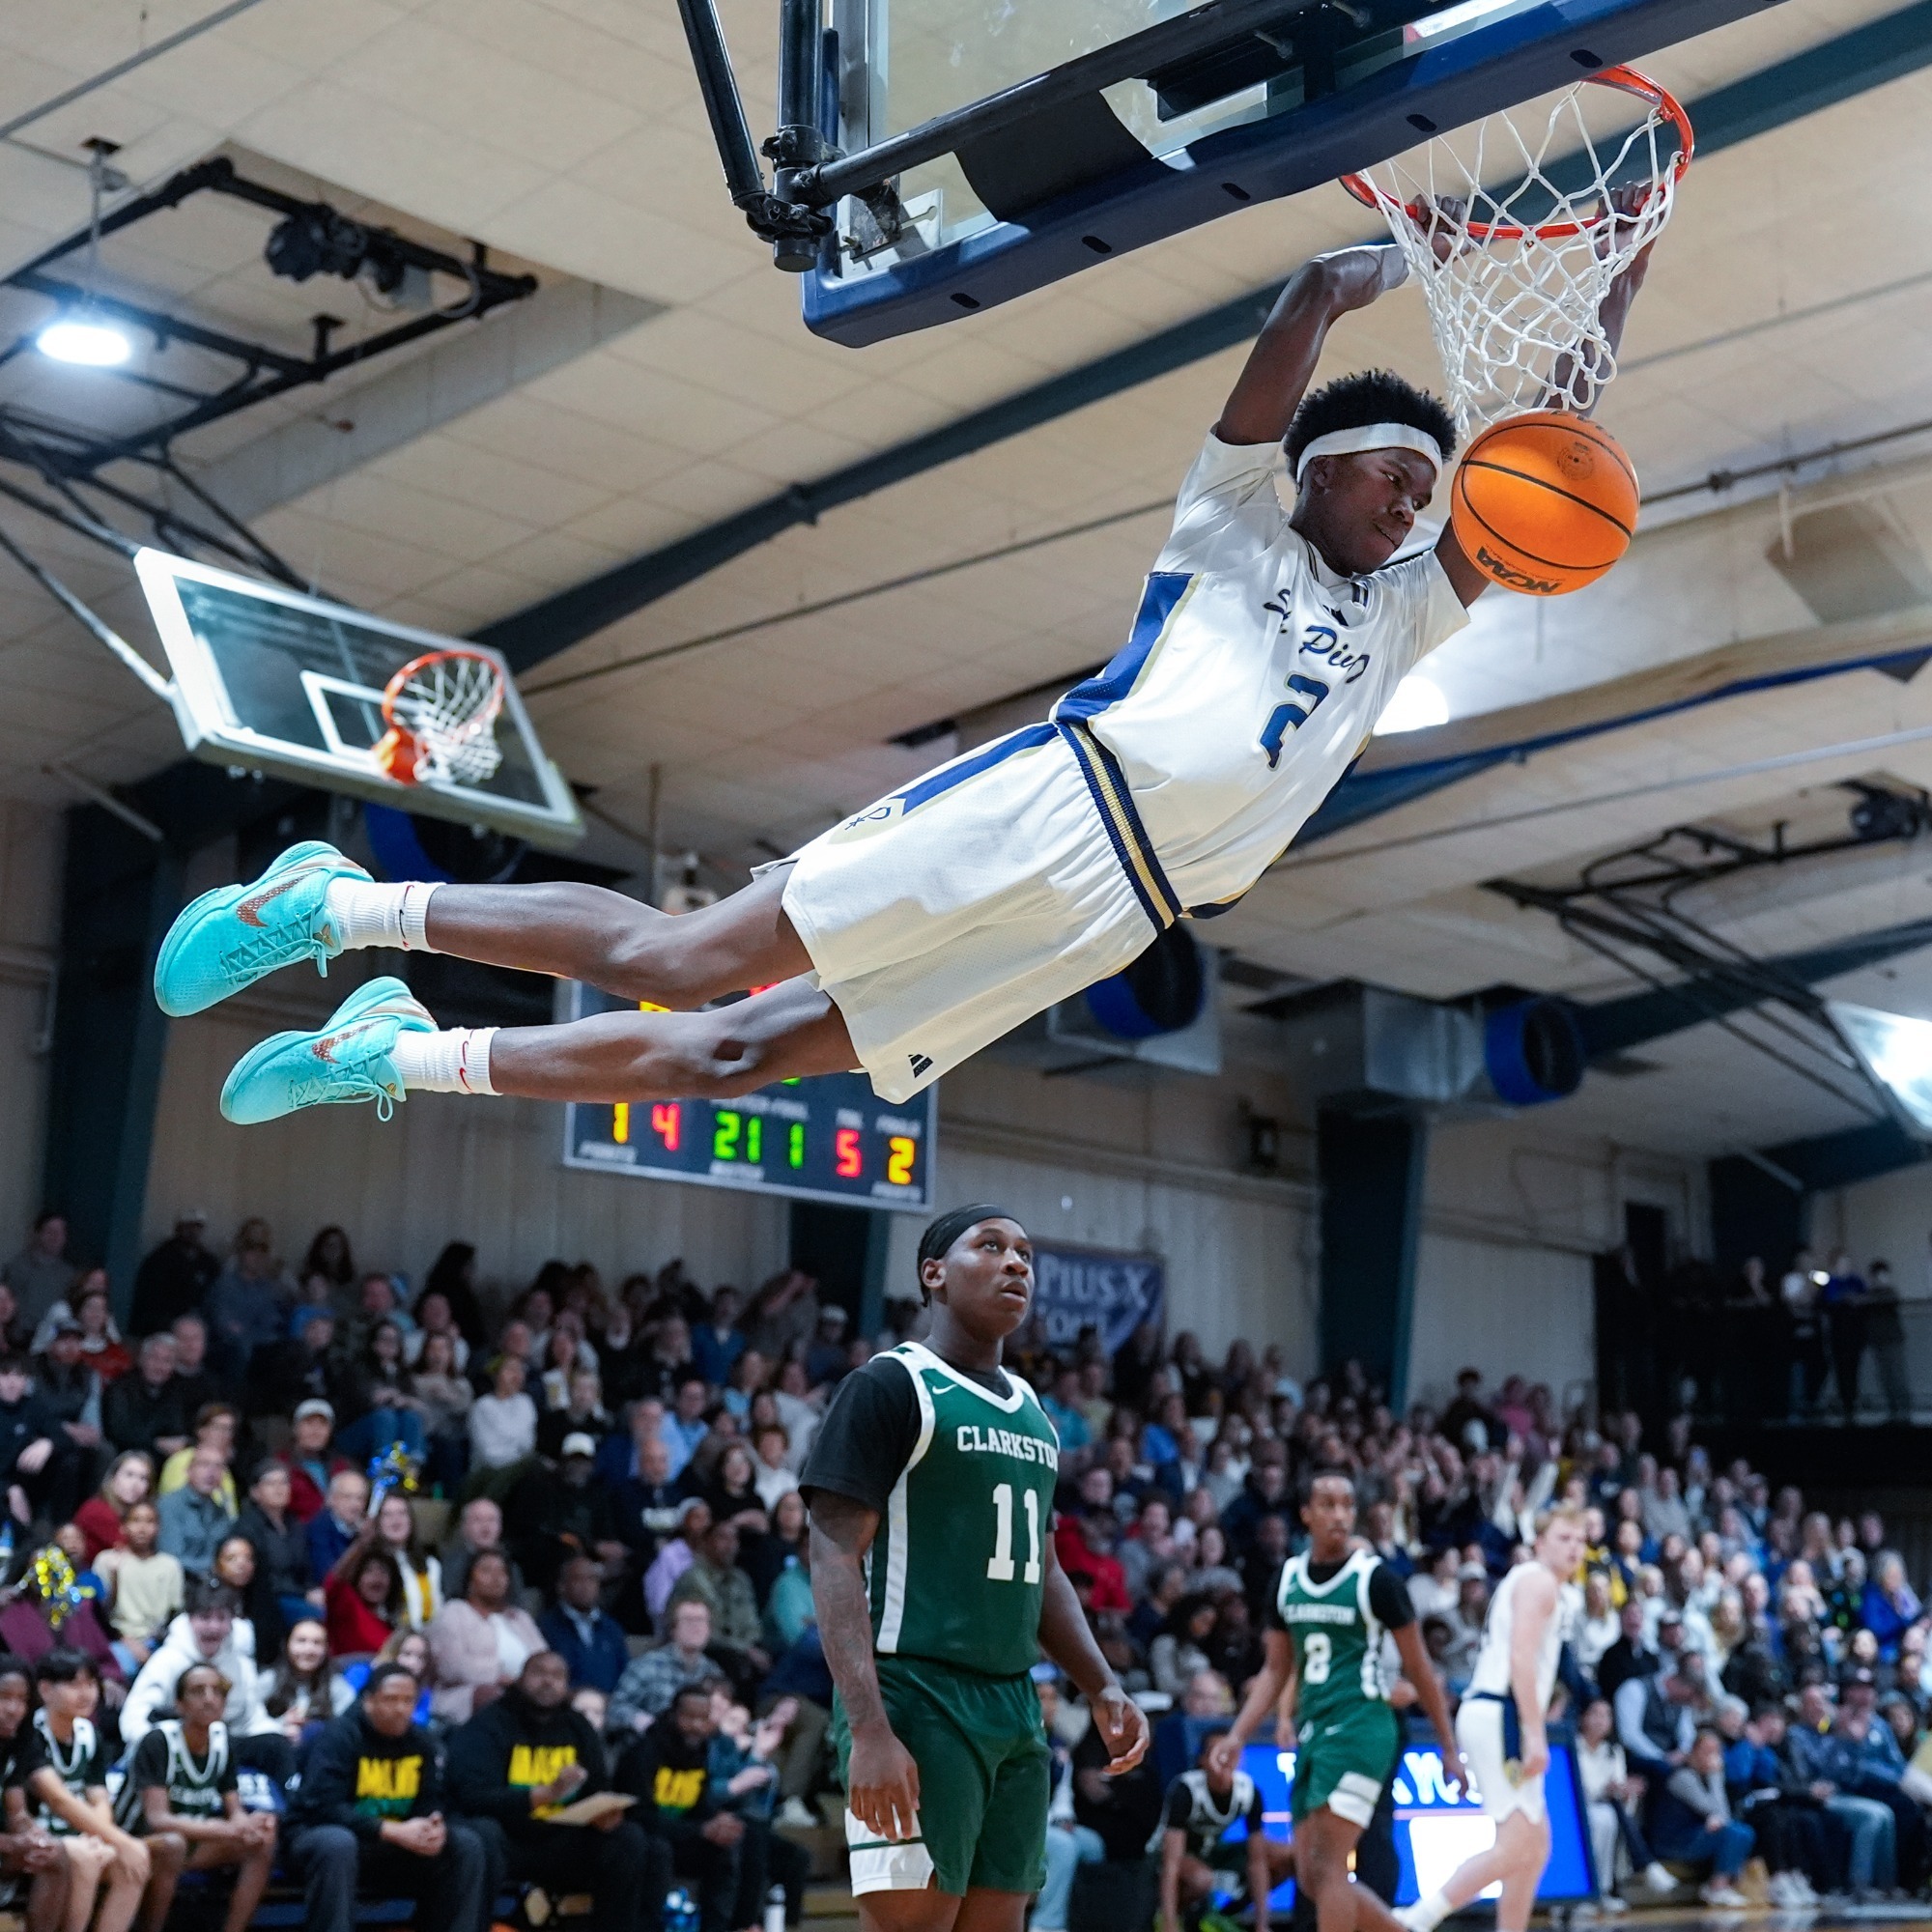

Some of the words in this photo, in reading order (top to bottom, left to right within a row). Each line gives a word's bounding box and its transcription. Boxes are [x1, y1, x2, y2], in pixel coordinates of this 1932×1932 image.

[1477, 546, 1560, 592] NCAA
[652, 1103, 681, 1151] 4
[713, 1111, 762, 1163] 21
[789, 1122, 805, 1169] 1
[836, 1128, 862, 1178] 5
[888, 1136, 915, 1185] 2
[1037, 1254, 1118, 1307] PIUS
[986, 1483, 1040, 1585] 11
